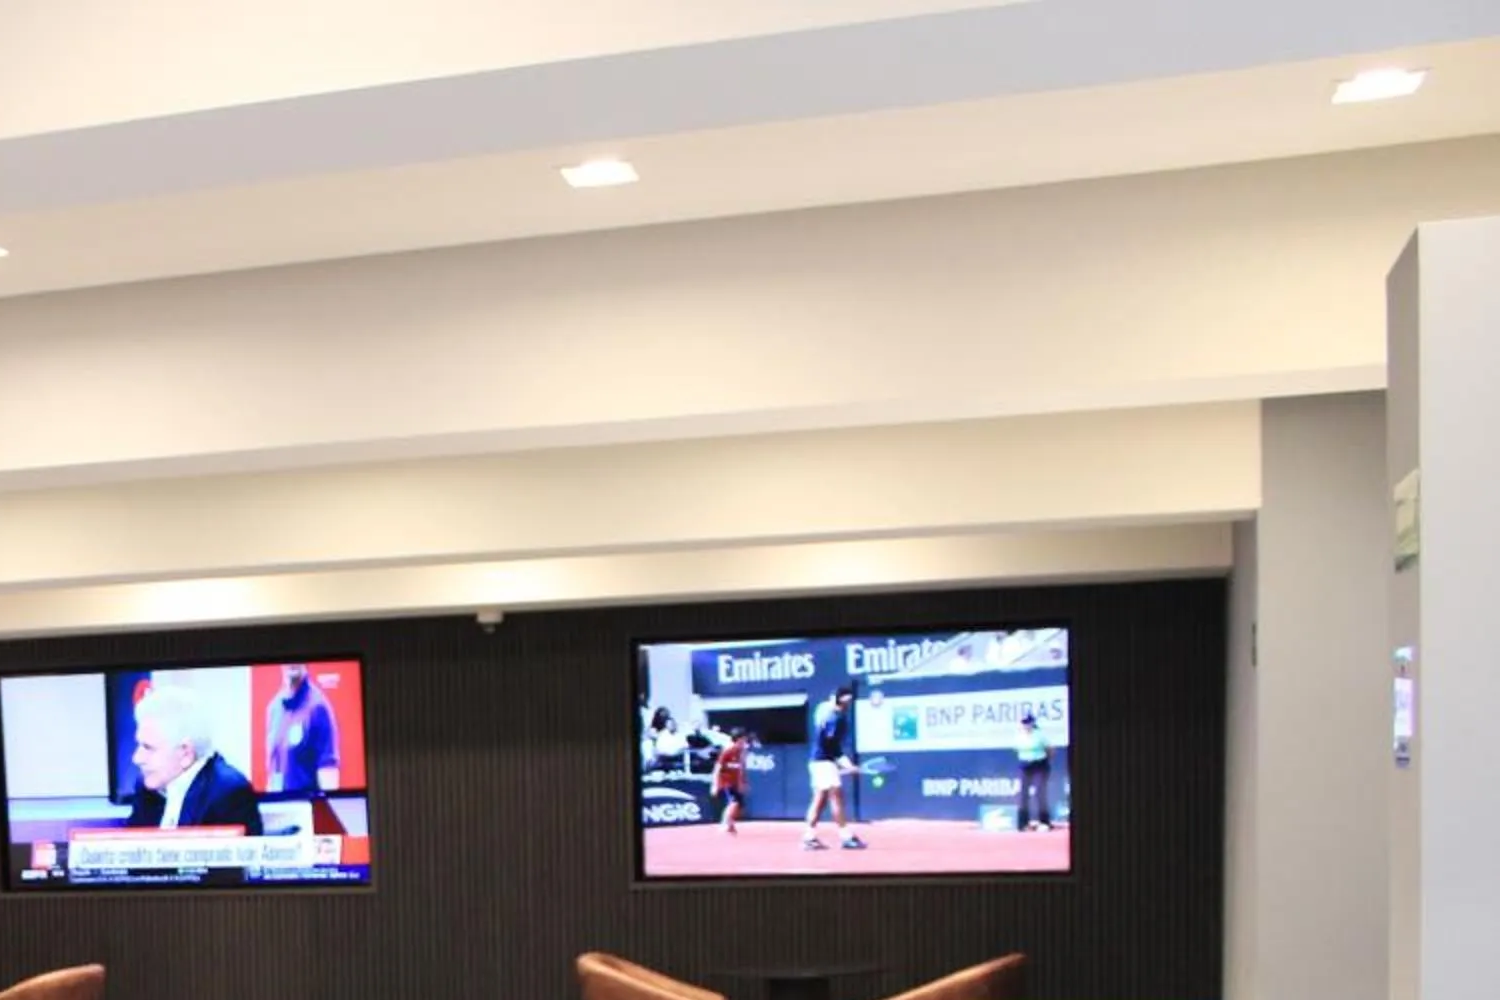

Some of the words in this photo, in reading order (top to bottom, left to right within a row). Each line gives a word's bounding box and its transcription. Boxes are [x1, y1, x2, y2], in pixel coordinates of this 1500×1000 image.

[718, 651, 815, 684] Emirates
[925, 705, 966, 728] BNP
[971, 698, 1064, 724] PARIBAS
[921, 778, 958, 798] BNP
